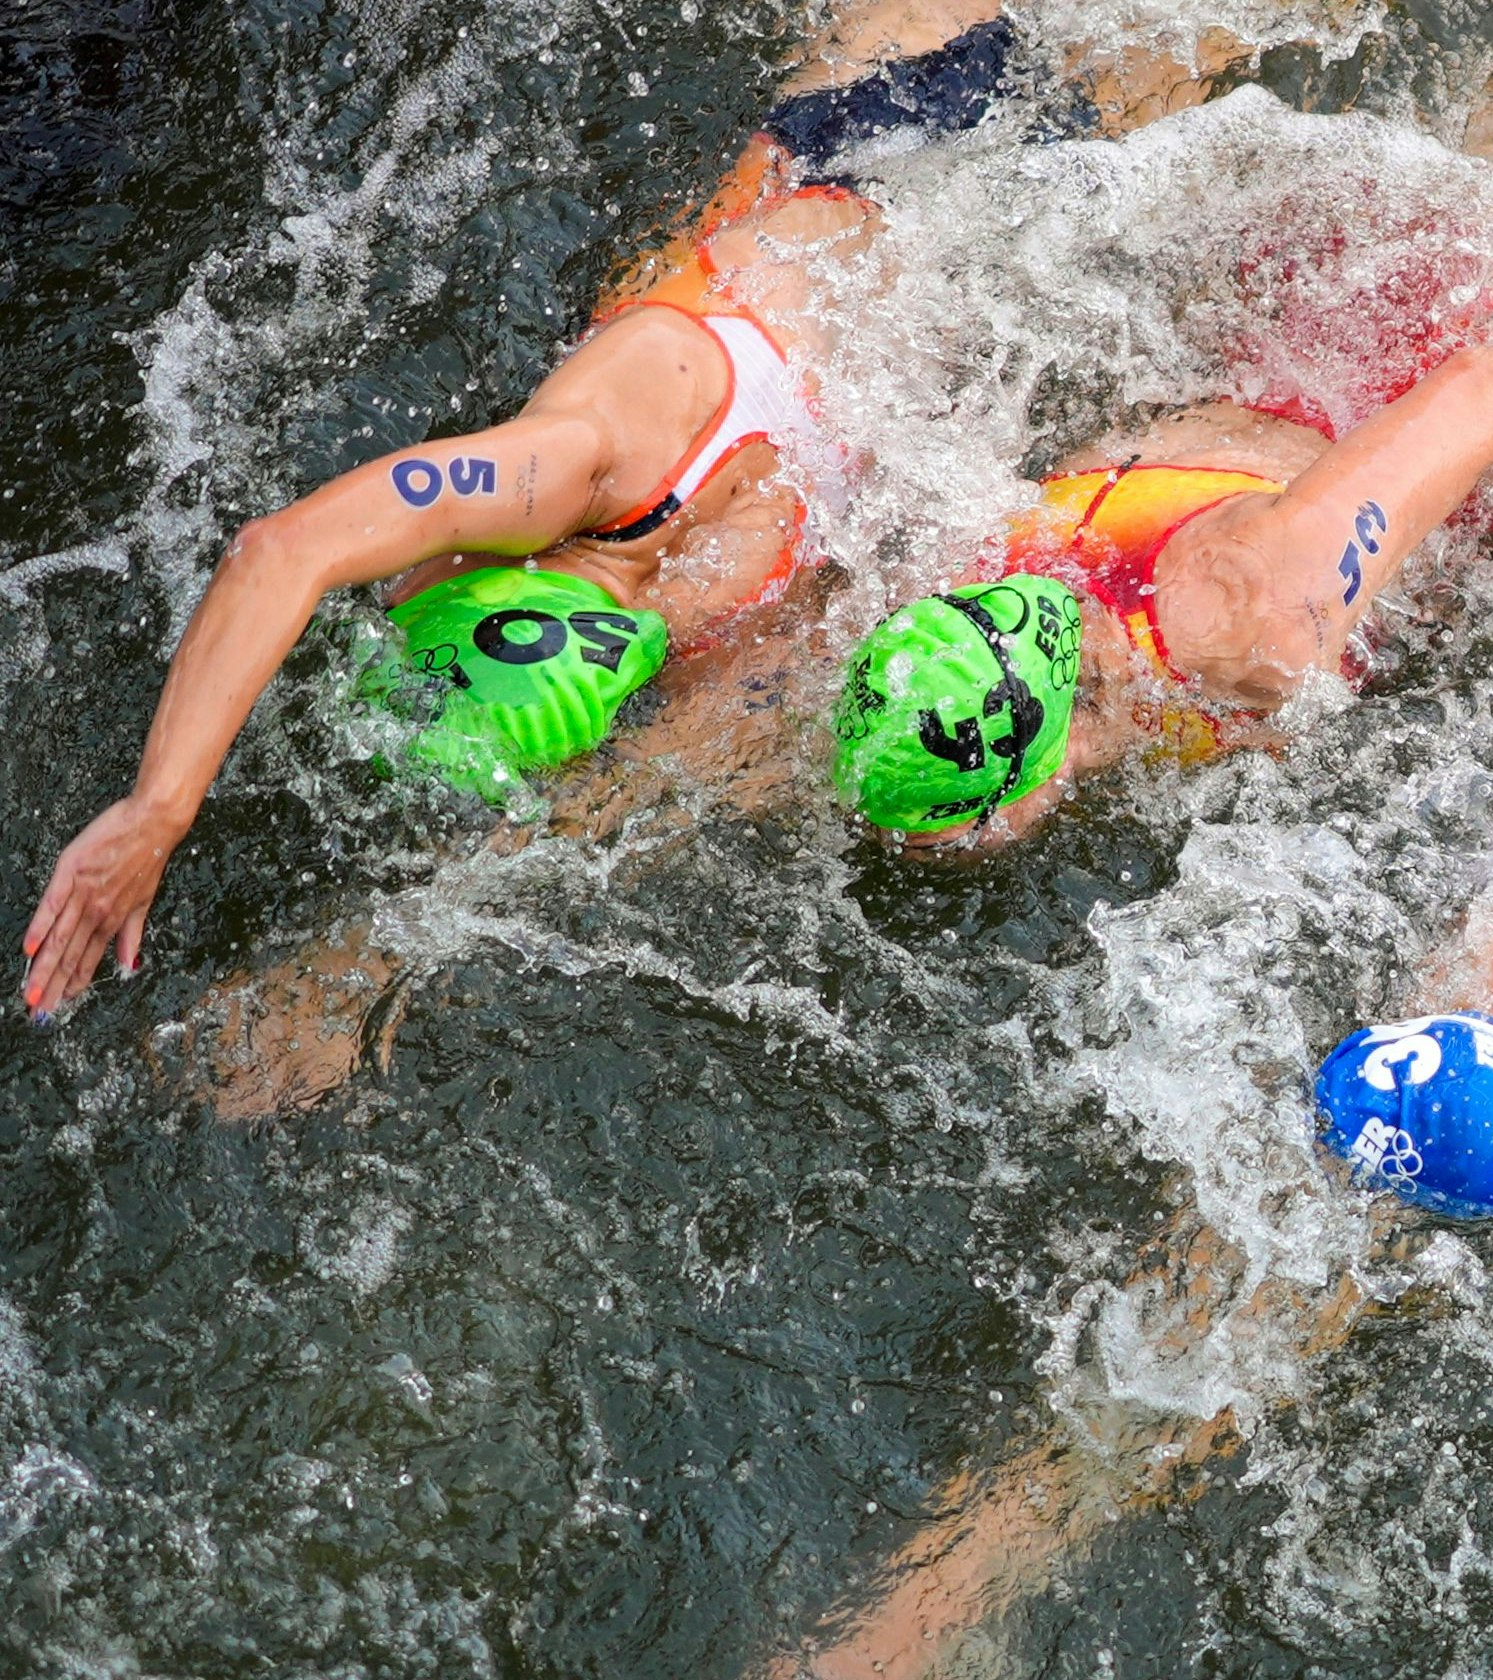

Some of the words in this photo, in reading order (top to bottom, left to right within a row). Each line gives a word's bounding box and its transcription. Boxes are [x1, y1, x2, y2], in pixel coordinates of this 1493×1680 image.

[390, 456, 496, 510] 50
[472, 608, 640, 674] 50
[1034, 595, 1063, 662] ESP
